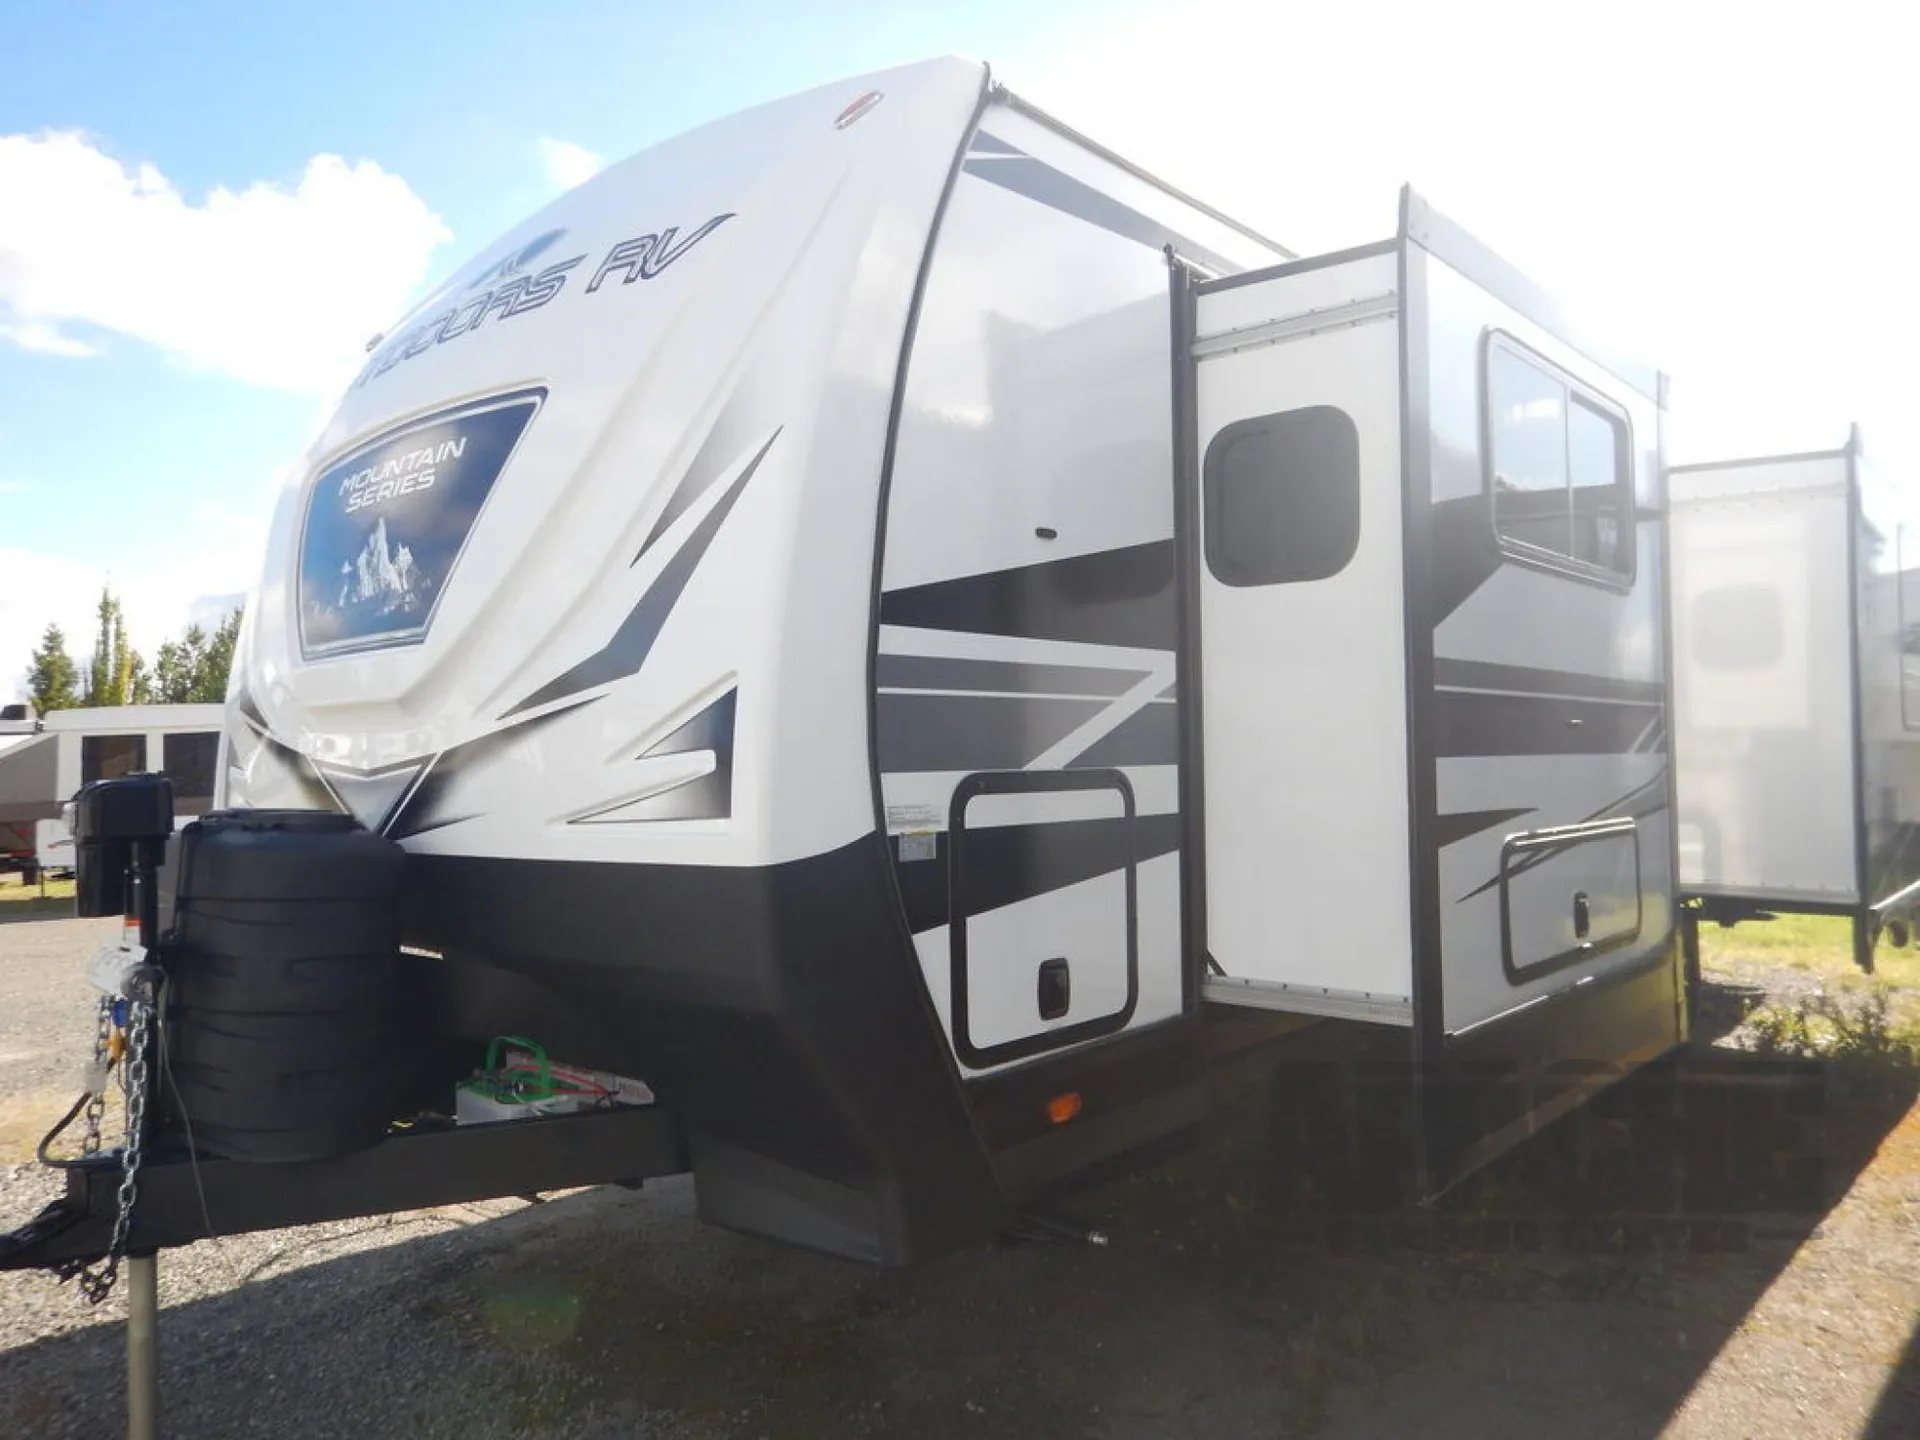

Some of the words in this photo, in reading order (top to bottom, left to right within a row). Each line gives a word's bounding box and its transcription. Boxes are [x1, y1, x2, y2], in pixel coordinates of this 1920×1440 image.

[585, 212, 738, 294] RV
[338, 436, 468, 496] MOUNTAIN
[345, 468, 436, 513] SERIES
